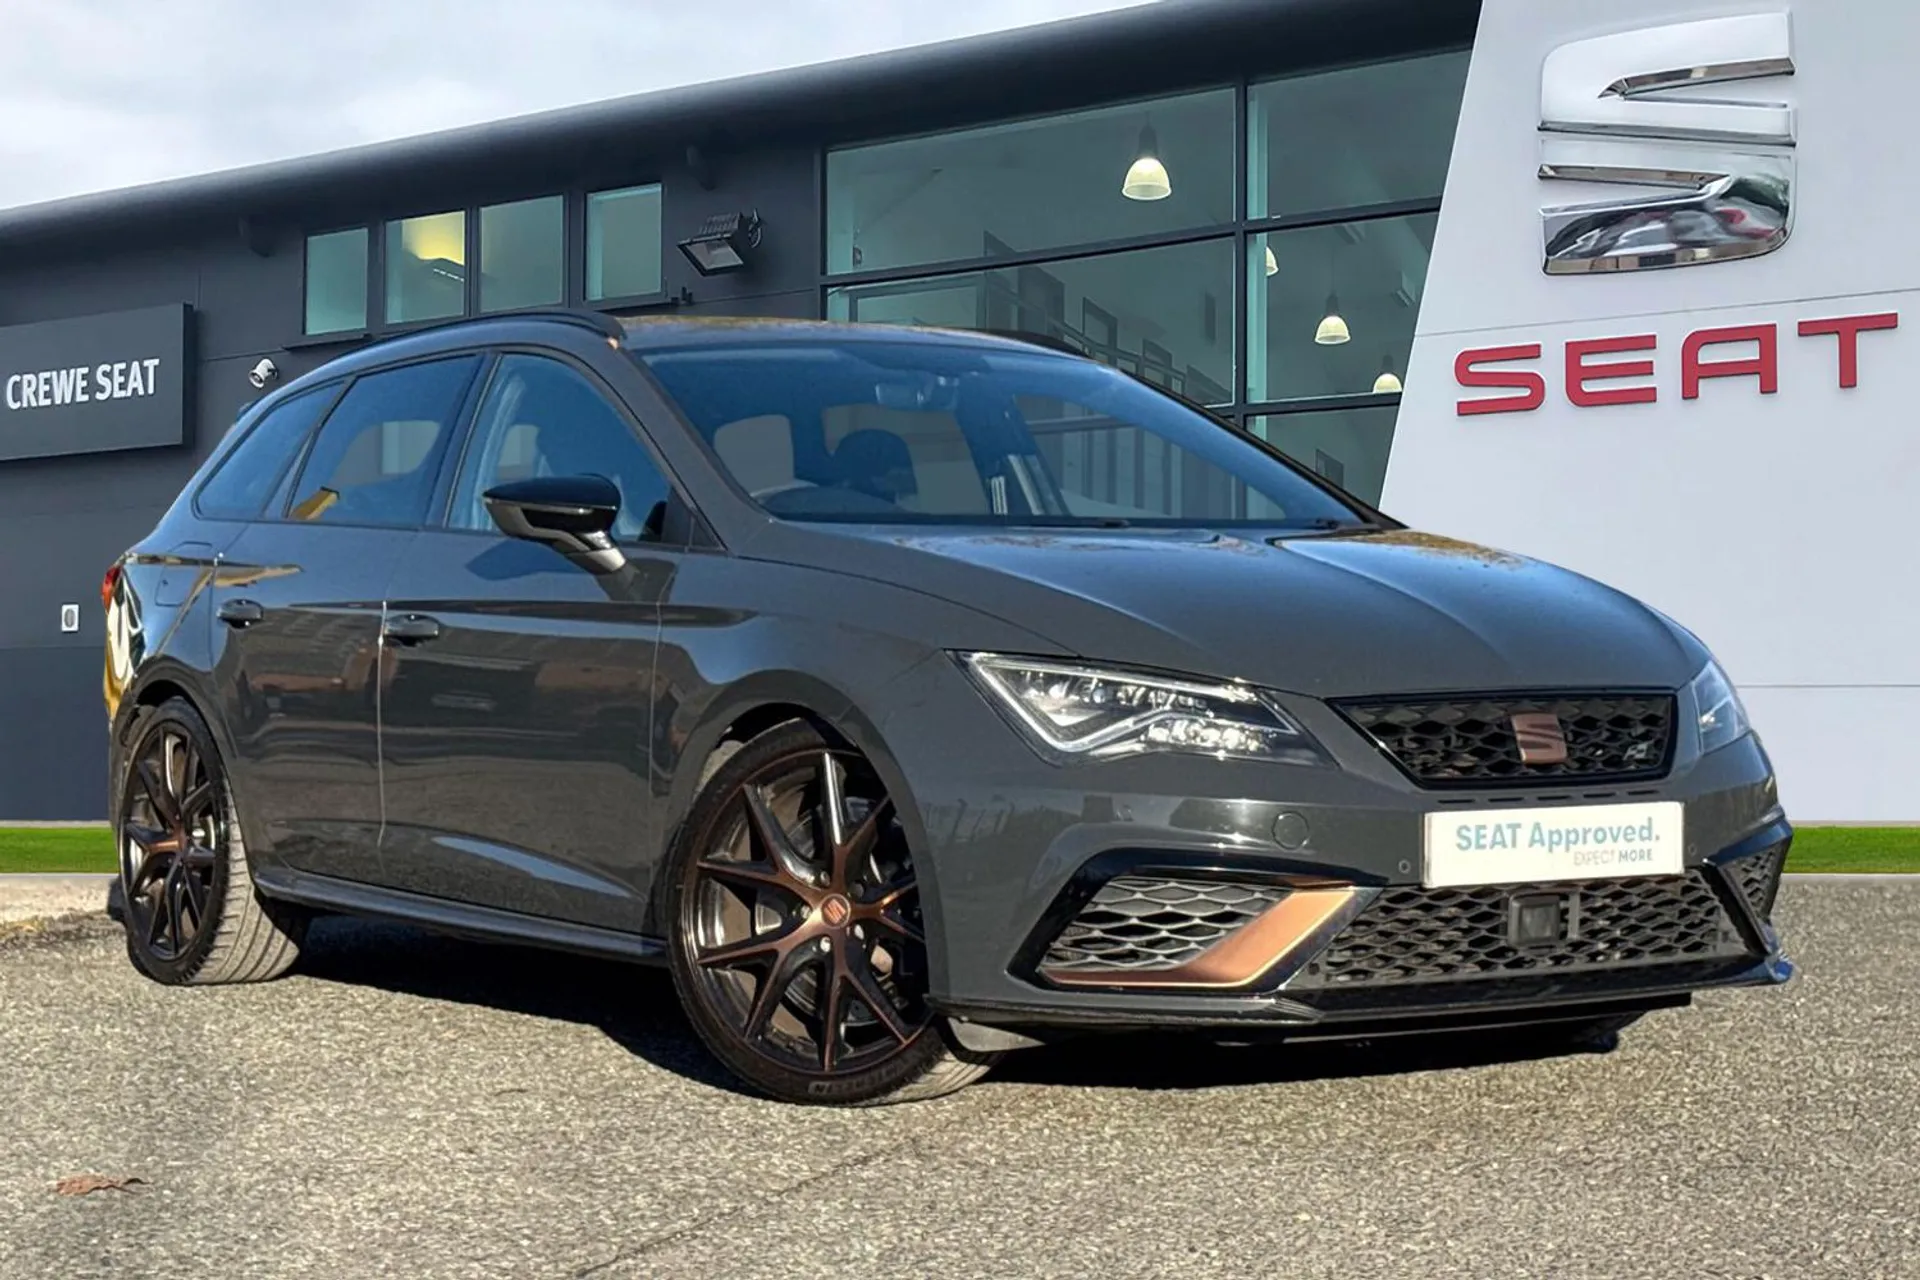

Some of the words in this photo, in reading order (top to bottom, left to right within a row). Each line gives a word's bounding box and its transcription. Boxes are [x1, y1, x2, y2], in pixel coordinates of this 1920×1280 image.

[6, 366, 90, 410] CREWE
[95, 358, 160, 401] SEAT
[1454, 312, 1898, 416] SEAT
[1456, 823, 1522, 851] SEAT
[1528, 816, 1660, 853] Approved.
[1618, 848, 1653, 863] MORE
